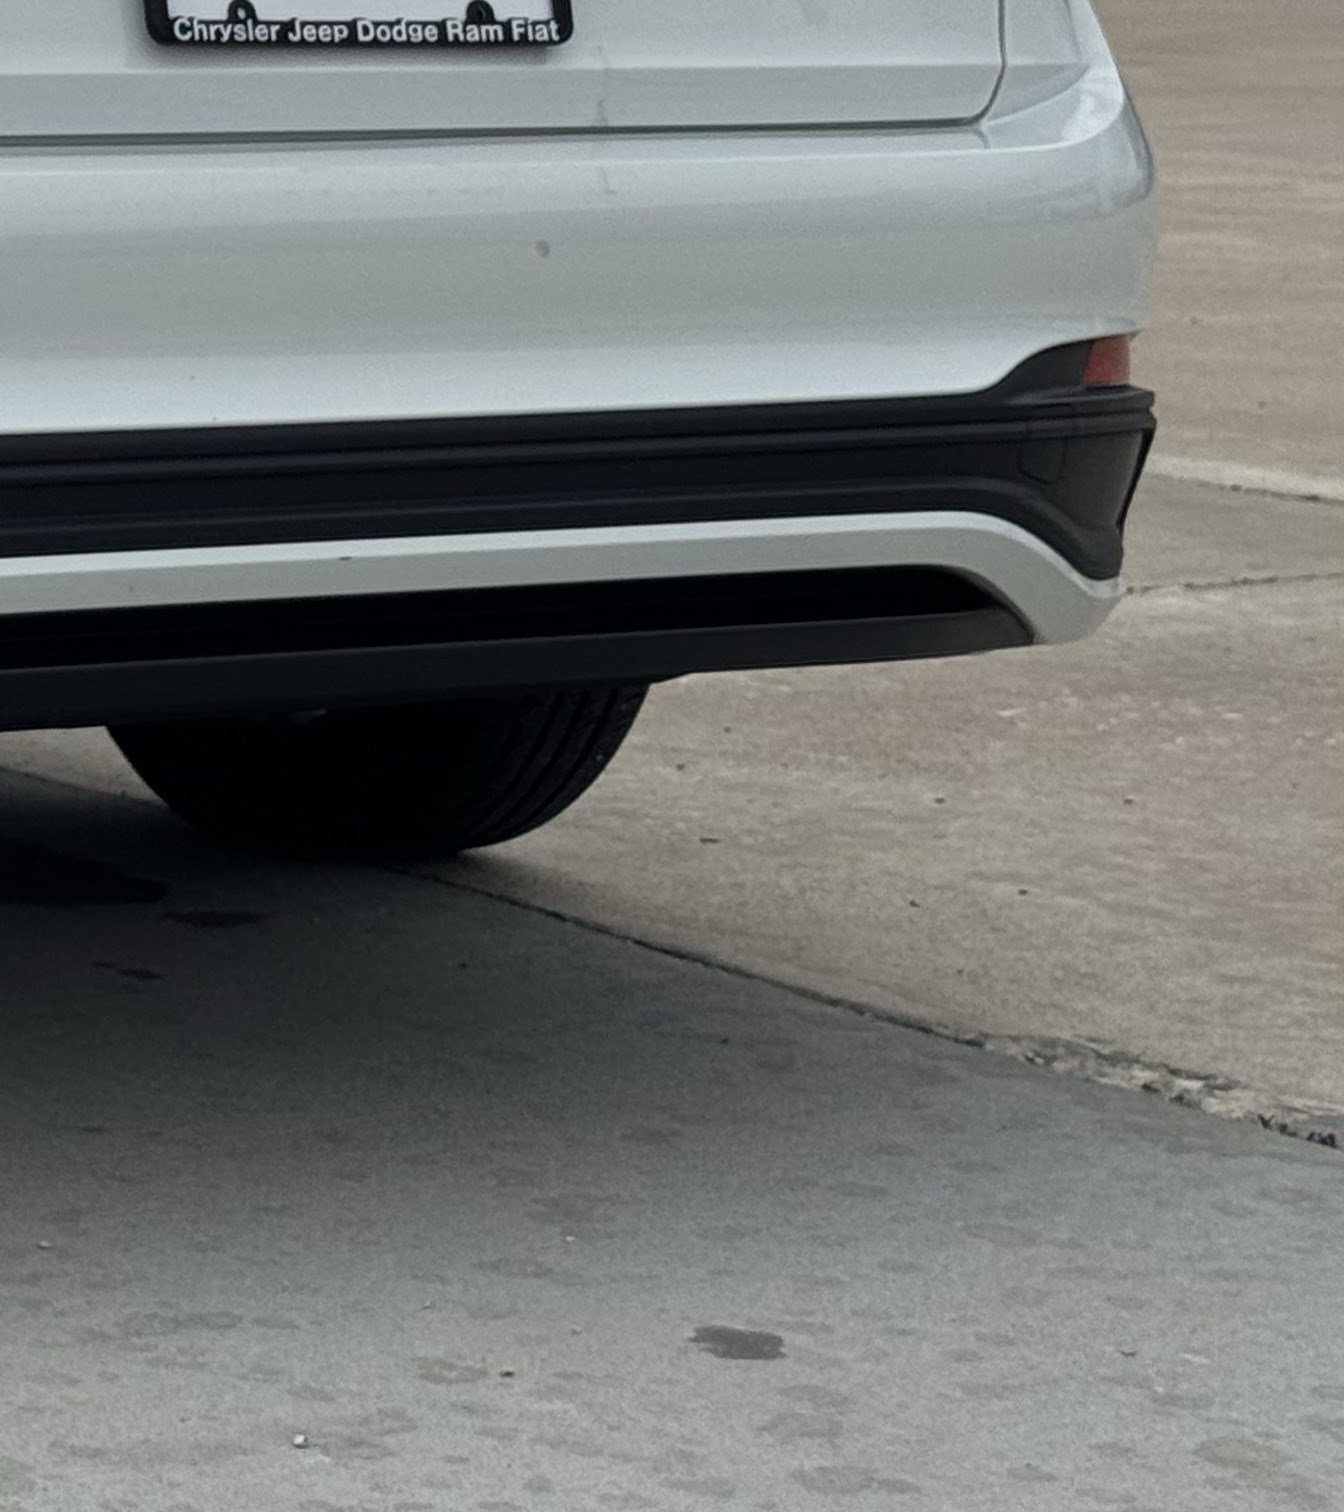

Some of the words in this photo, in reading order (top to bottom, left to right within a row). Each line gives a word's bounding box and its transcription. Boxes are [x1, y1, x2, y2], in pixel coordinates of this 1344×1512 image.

[173, 17, 279, 42] Chrysler
[288, 19, 349, 44] Jeep
[357, 19, 438, 43] Dodge
[447, 19, 503, 42] Ram
[512, 19, 560, 42] Fiat
